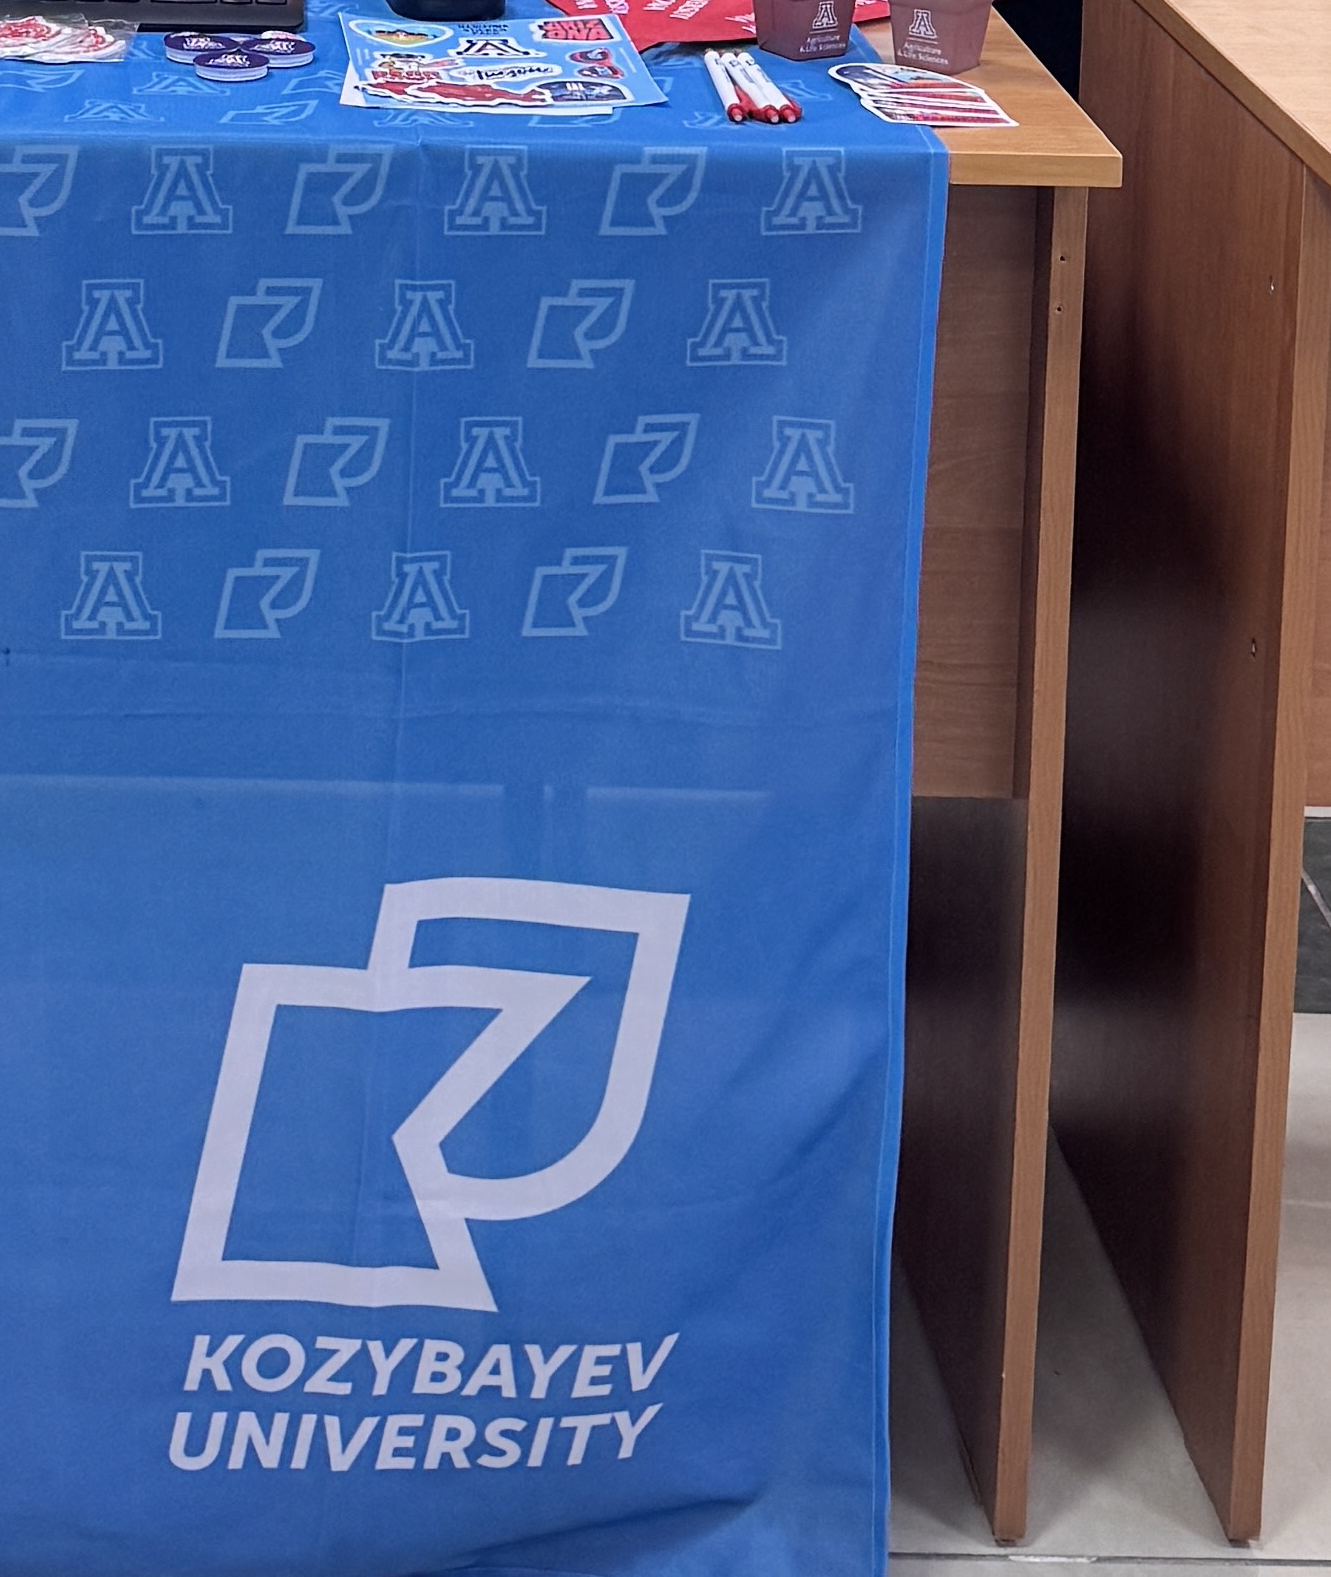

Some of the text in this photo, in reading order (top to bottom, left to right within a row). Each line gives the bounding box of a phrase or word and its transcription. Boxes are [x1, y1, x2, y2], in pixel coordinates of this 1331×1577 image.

[805, 35, 841, 47] Agriculture
[904, 42, 942, 55] Agriculture
[919, 53, 948, 65] Sciences
[182, 1331, 681, 1399] KOZYBAYEV
[169, 1403, 664, 1472] UNIVERSITY
